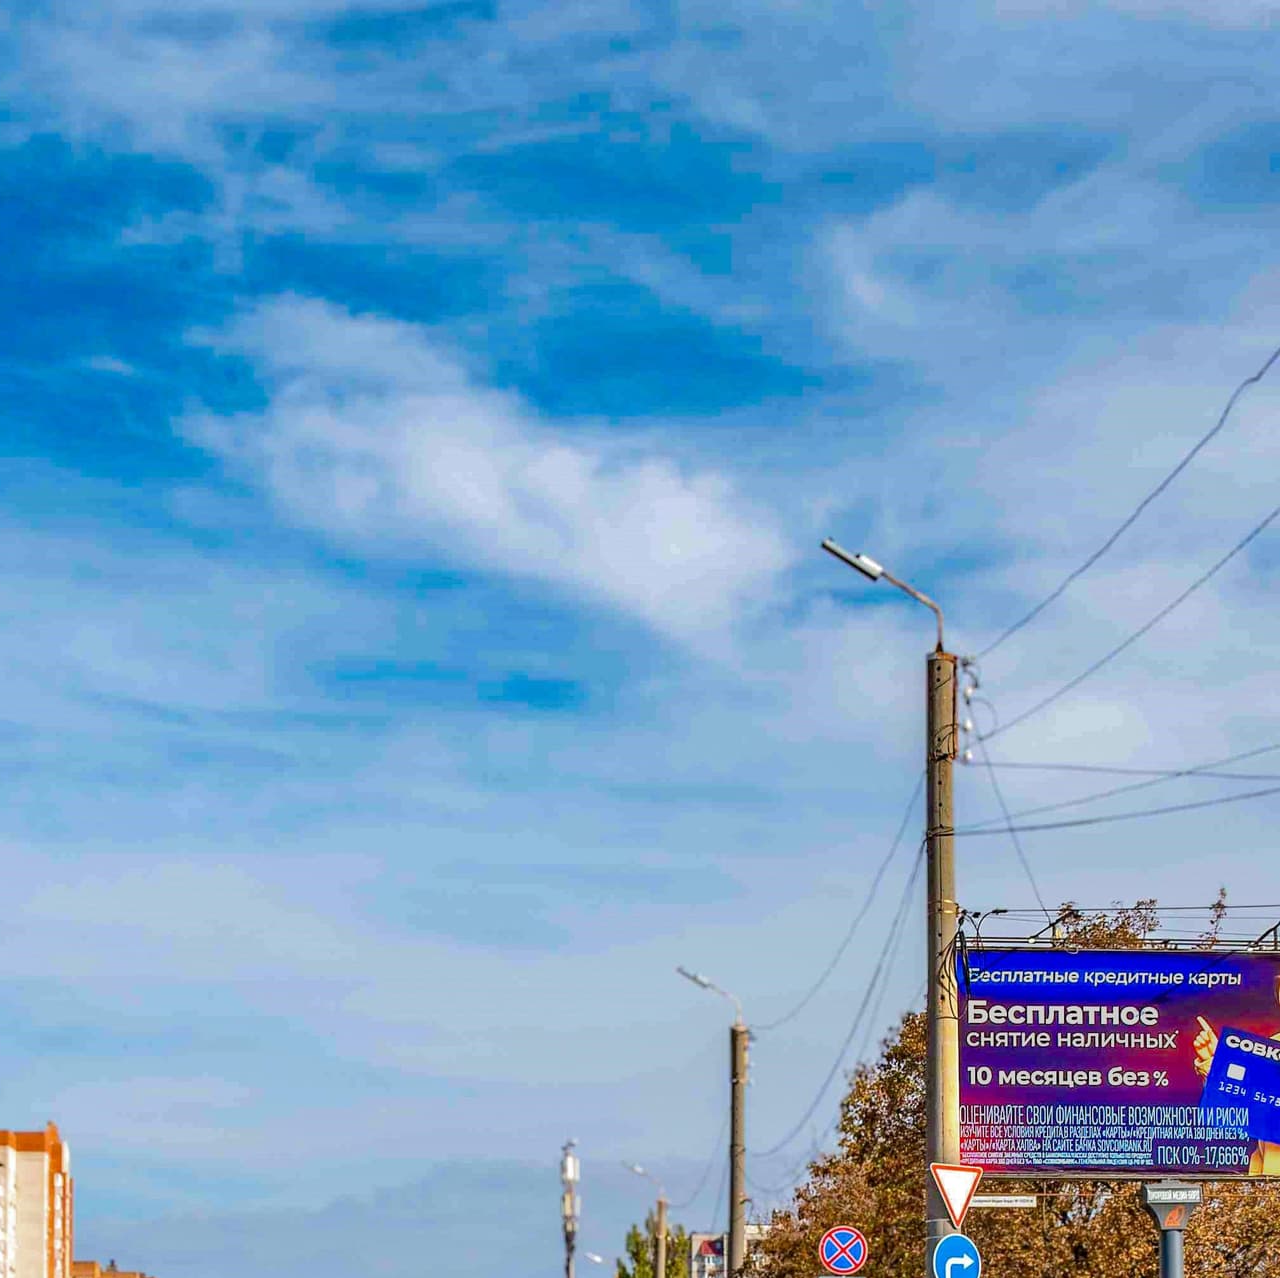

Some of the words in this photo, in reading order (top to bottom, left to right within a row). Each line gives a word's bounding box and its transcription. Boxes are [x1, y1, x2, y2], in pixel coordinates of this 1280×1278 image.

[1083, 971, 1184, 987] кредитные
[1188, 972, 1241, 988] карты
[967, 1000, 1159, 1026] Бесплатное
[966, 1031, 1050, 1048] снятие
[967, 1066, 992, 1085] 10
[999, 1069, 1102, 1089] месяцев
[1107, 1066, 1150, 1086] без
[1153, 1071, 1169, 1087] %
[1218, 1081, 1247, 1097] 1234
[960, 1104, 1024, 1127] ОЦЕНИВАЙТЕ
[1026, 1105, 1053, 1125] СВОИ
[1056, 1105, 1126, 1126] ФИНАНСОВЫЕ
[1129, 1106, 1204, 1126] ВОЗМОЖНОСТИ
[1207, 1107, 1214, 1126] И
[1216, 1107, 1249, 1126] РИСКИ
[1158, 1146, 1180, 1165] ПСК
